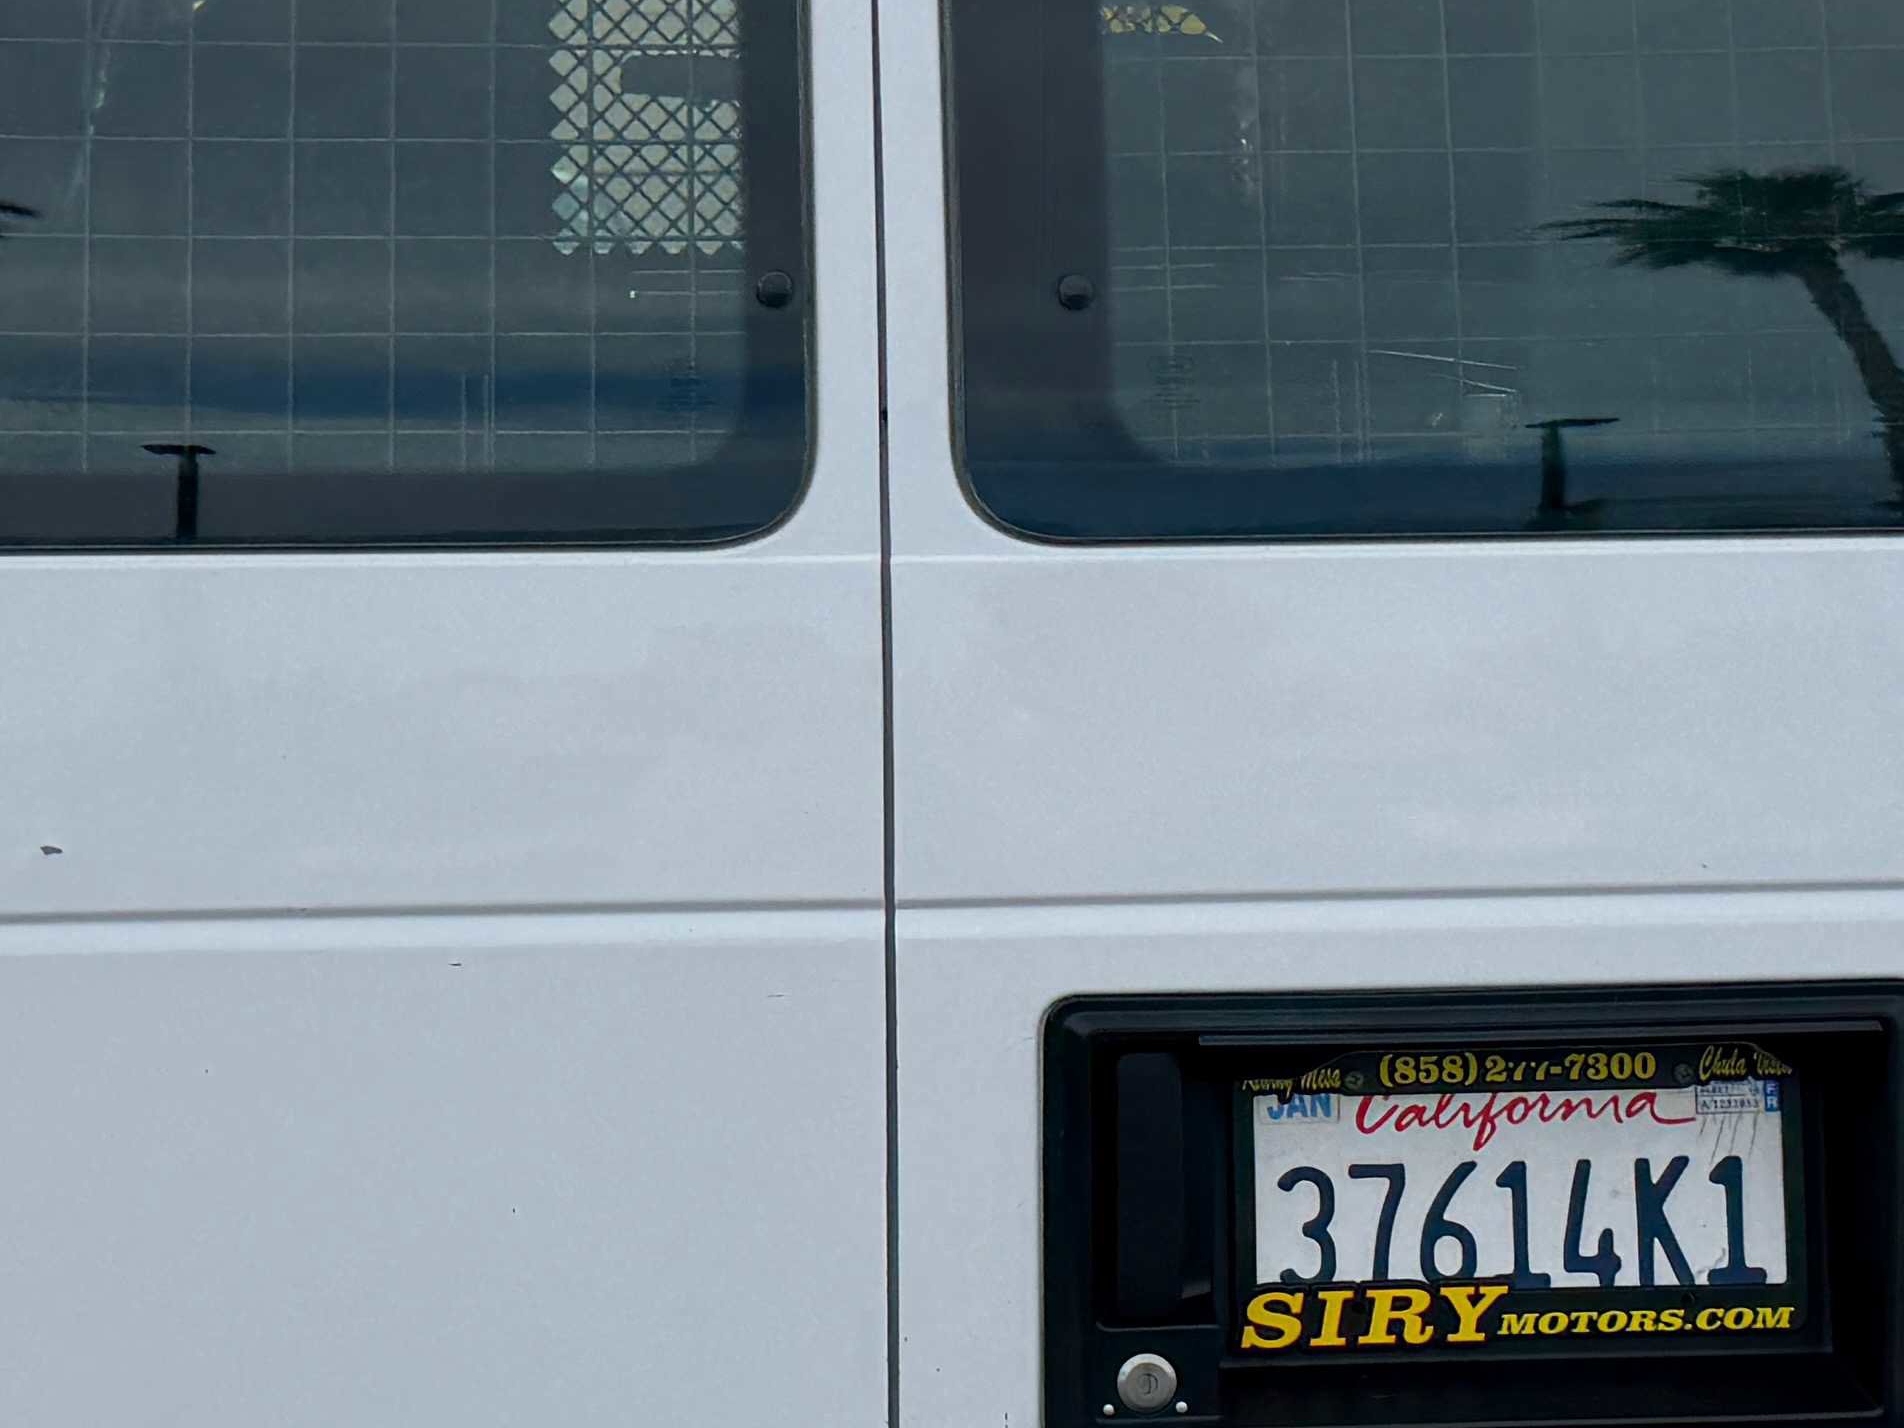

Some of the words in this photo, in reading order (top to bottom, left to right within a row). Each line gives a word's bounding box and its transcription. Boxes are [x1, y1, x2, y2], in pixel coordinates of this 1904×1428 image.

[1380, 1051, 1478, 1088] (858)
[1485, 1051, 1657, 1082] 277-7300
[1266, 1093, 1332, 1121] JAN
[1354, 1091, 1696, 1152] California
[1276, 1154, 1768, 1288] 37614K1
[1240, 1285, 1508, 1349] SIRY
[1501, 1306, 1795, 1336] MOTORS.COM
